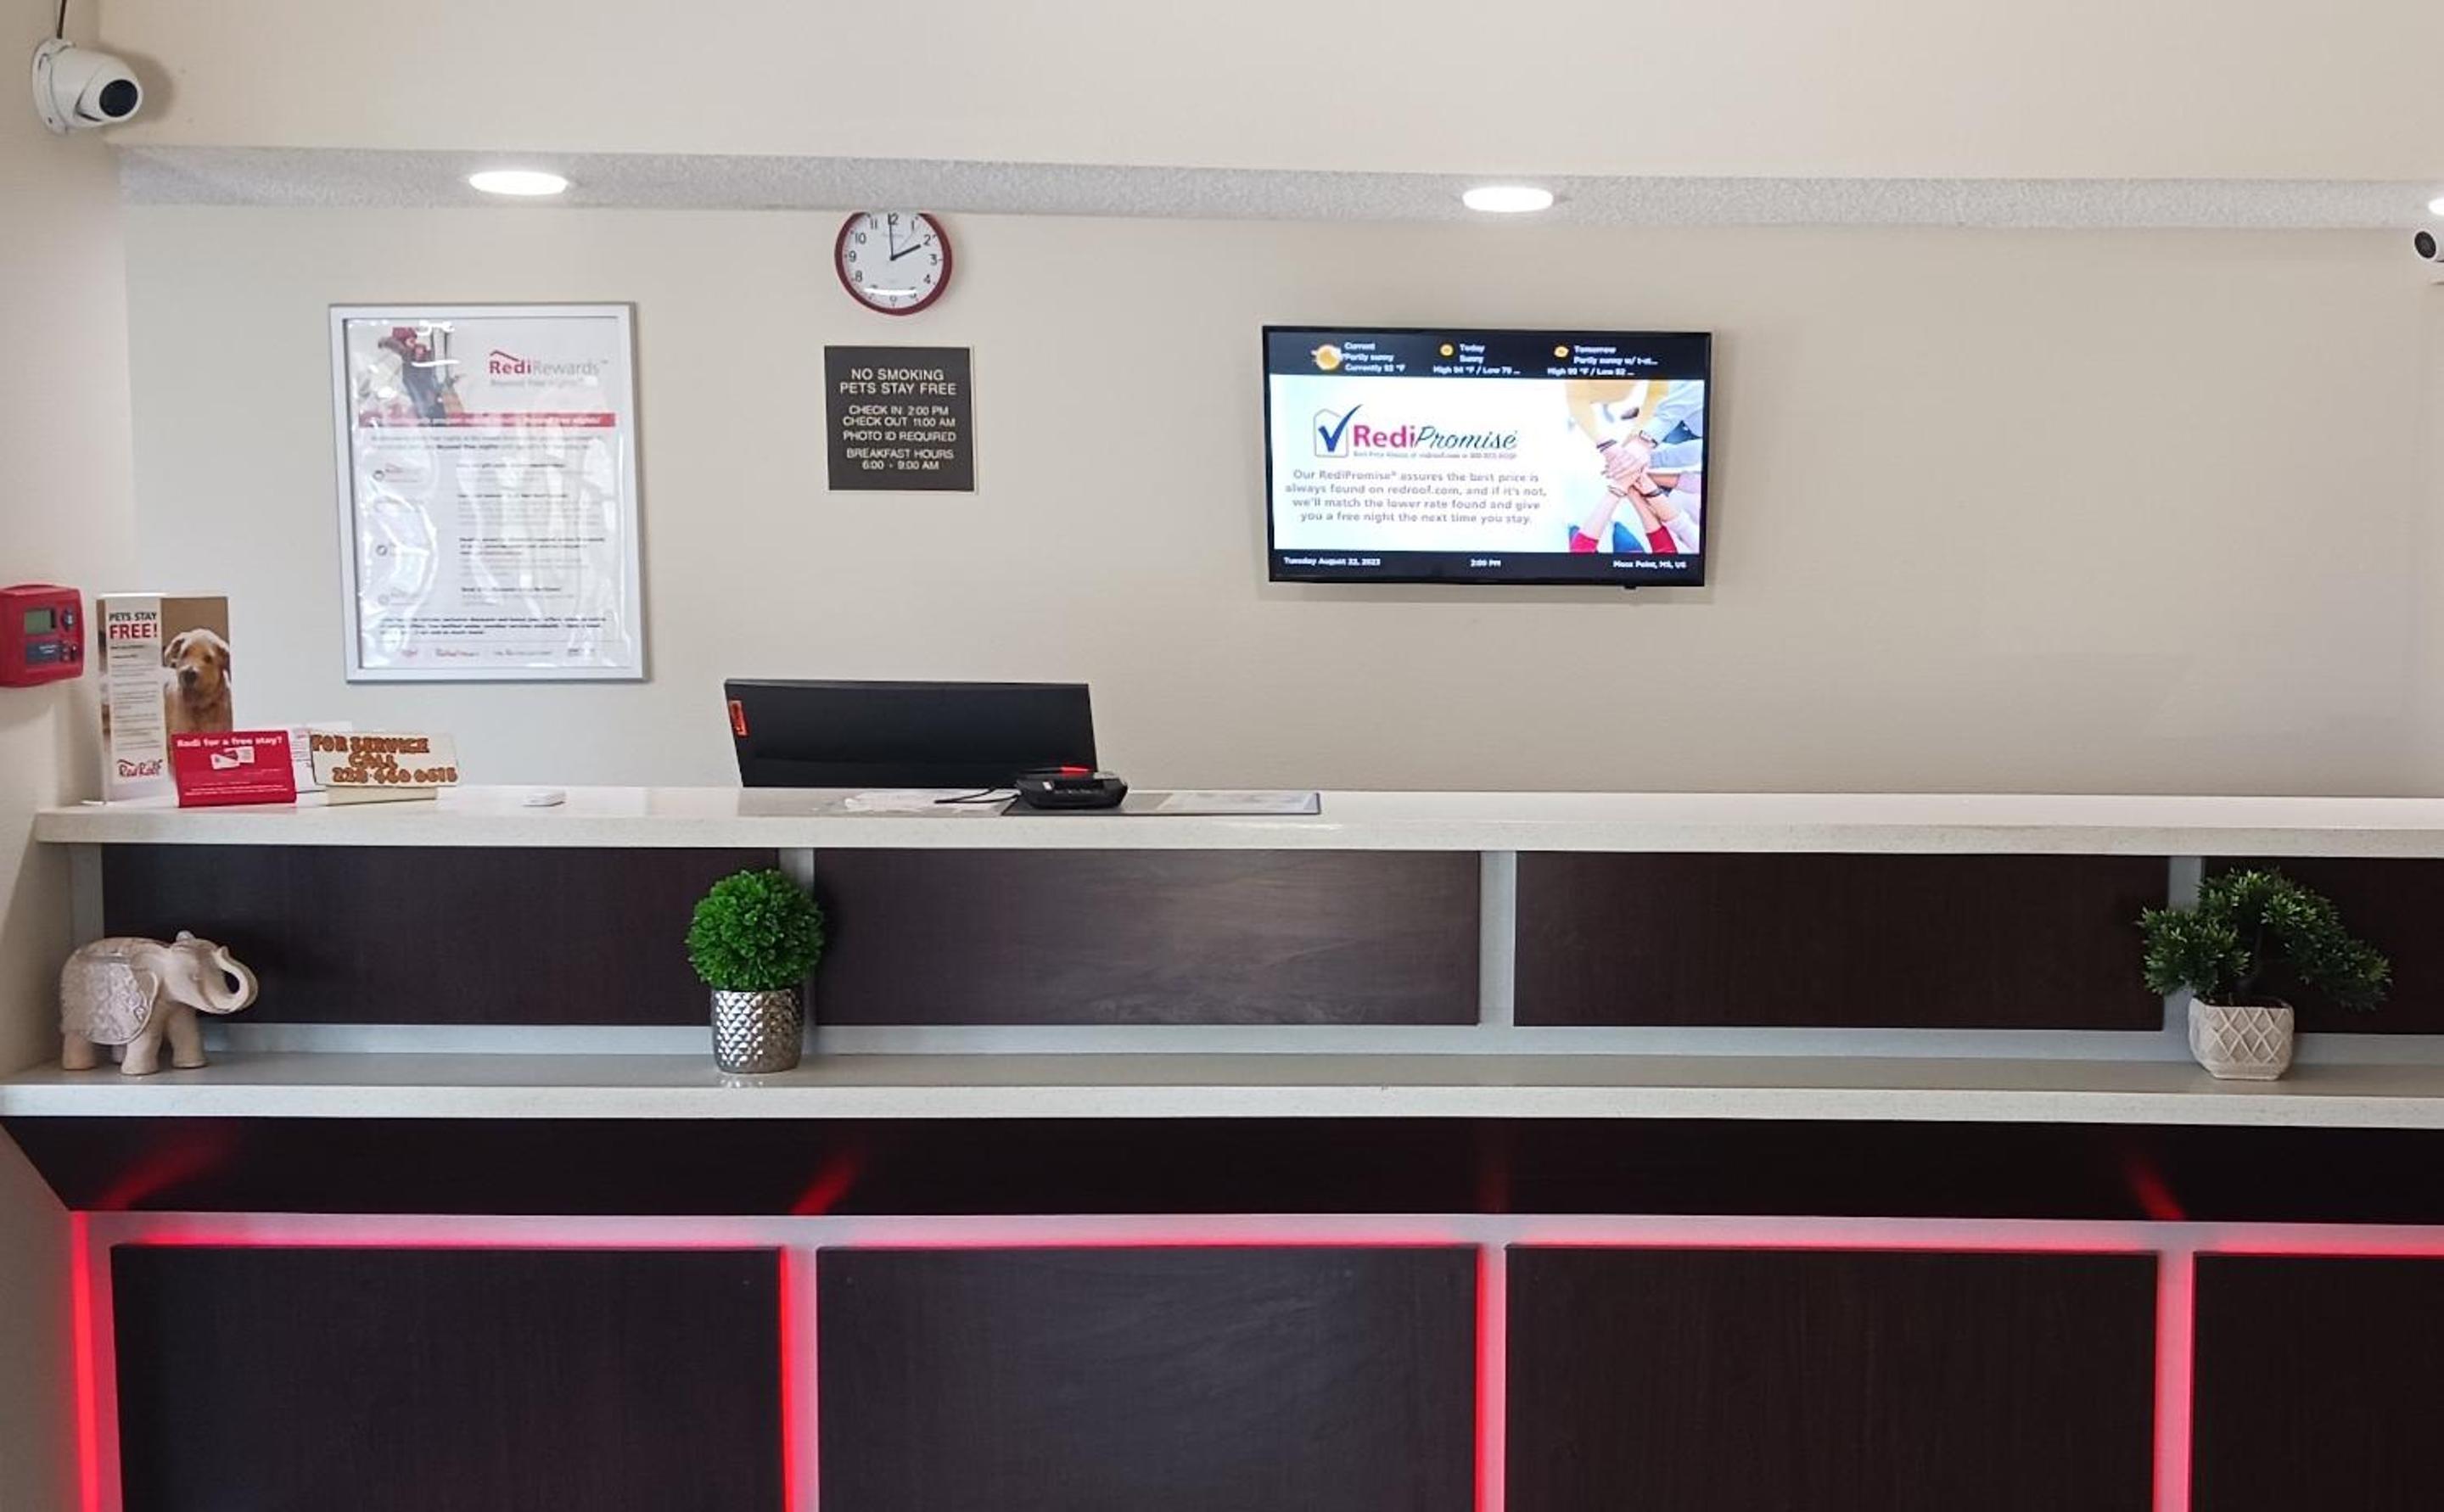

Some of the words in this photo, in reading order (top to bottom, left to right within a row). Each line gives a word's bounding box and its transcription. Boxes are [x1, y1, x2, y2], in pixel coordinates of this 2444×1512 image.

[870, 218, 877, 229] 11
[855, 232, 866, 244] 10
[923, 234, 931, 246] 2
[849, 250, 856, 262] 9
[929, 254, 937, 266] 3
[855, 271, 862, 283] 8
[923, 274, 931, 284] 4
[851, 367, 873, 380] NO
[877, 368, 945, 381] SMOKING
[840, 382, 877, 395] PETS
[881, 383, 915, 395] STAY
[920, 383, 957, 395] FREE
[849, 405, 888, 415] CHECK
[890, 405, 902, 415] IN
[932, 406, 949, 416] PM
[843, 417, 882, 426] CHECK
[884, 417, 908, 426] OUT
[939, 417, 956, 427] AM
[843, 429, 883, 440] PHOTO
[885, 431, 896, 440] ID
[899, 431, 956, 441] REQUIRED
[846, 448, 911, 458] BREAKFAST
[914, 449, 954, 459] HOURS
[862, 460, 884, 470] 6:00
[922, 461, 939, 470] AM
[1293, 469, 1314, 479] Our
[1400, 473, 1443, 481] assures
[1447, 473, 1466, 481] the
[1470, 473, 1494, 481] best
[1498, 473, 1526, 483] price
[1529, 473, 1539, 482] is
[1286, 484, 1326, 495] always
[1331, 484, 1365, 493] found
[1466, 486, 1488, 496] and
[1492, 486, 1499, 496] if
[1325, 498, 1360, 507] match
[1365, 499, 1383, 507] the
[1387, 499, 1421, 507] lower
[1425, 500, 1448, 508] rate
[1452, 499, 1487, 509] found
[1490, 500, 1512, 509] and
[1516, 501, 1540, 511] give
[1301, 512, 1322, 522] you
[1337, 512, 1359, 520] free
[1364, 512, 1395, 524] night
[1399, 512, 1418, 522] the
[1451, 513, 1477, 522] time
[1481, 515, 1503, 525] you
[109, 612, 131, 621] PETS
[134, 612, 157, 621] STAY
[109, 623, 158, 639] FREE!
[204, 738, 220, 747] for
[231, 736, 253, 745] free
[255, 736, 283, 746] stay?
[311, 734, 348, 752] FOR
[350, 736, 430, 753] SERVICE
